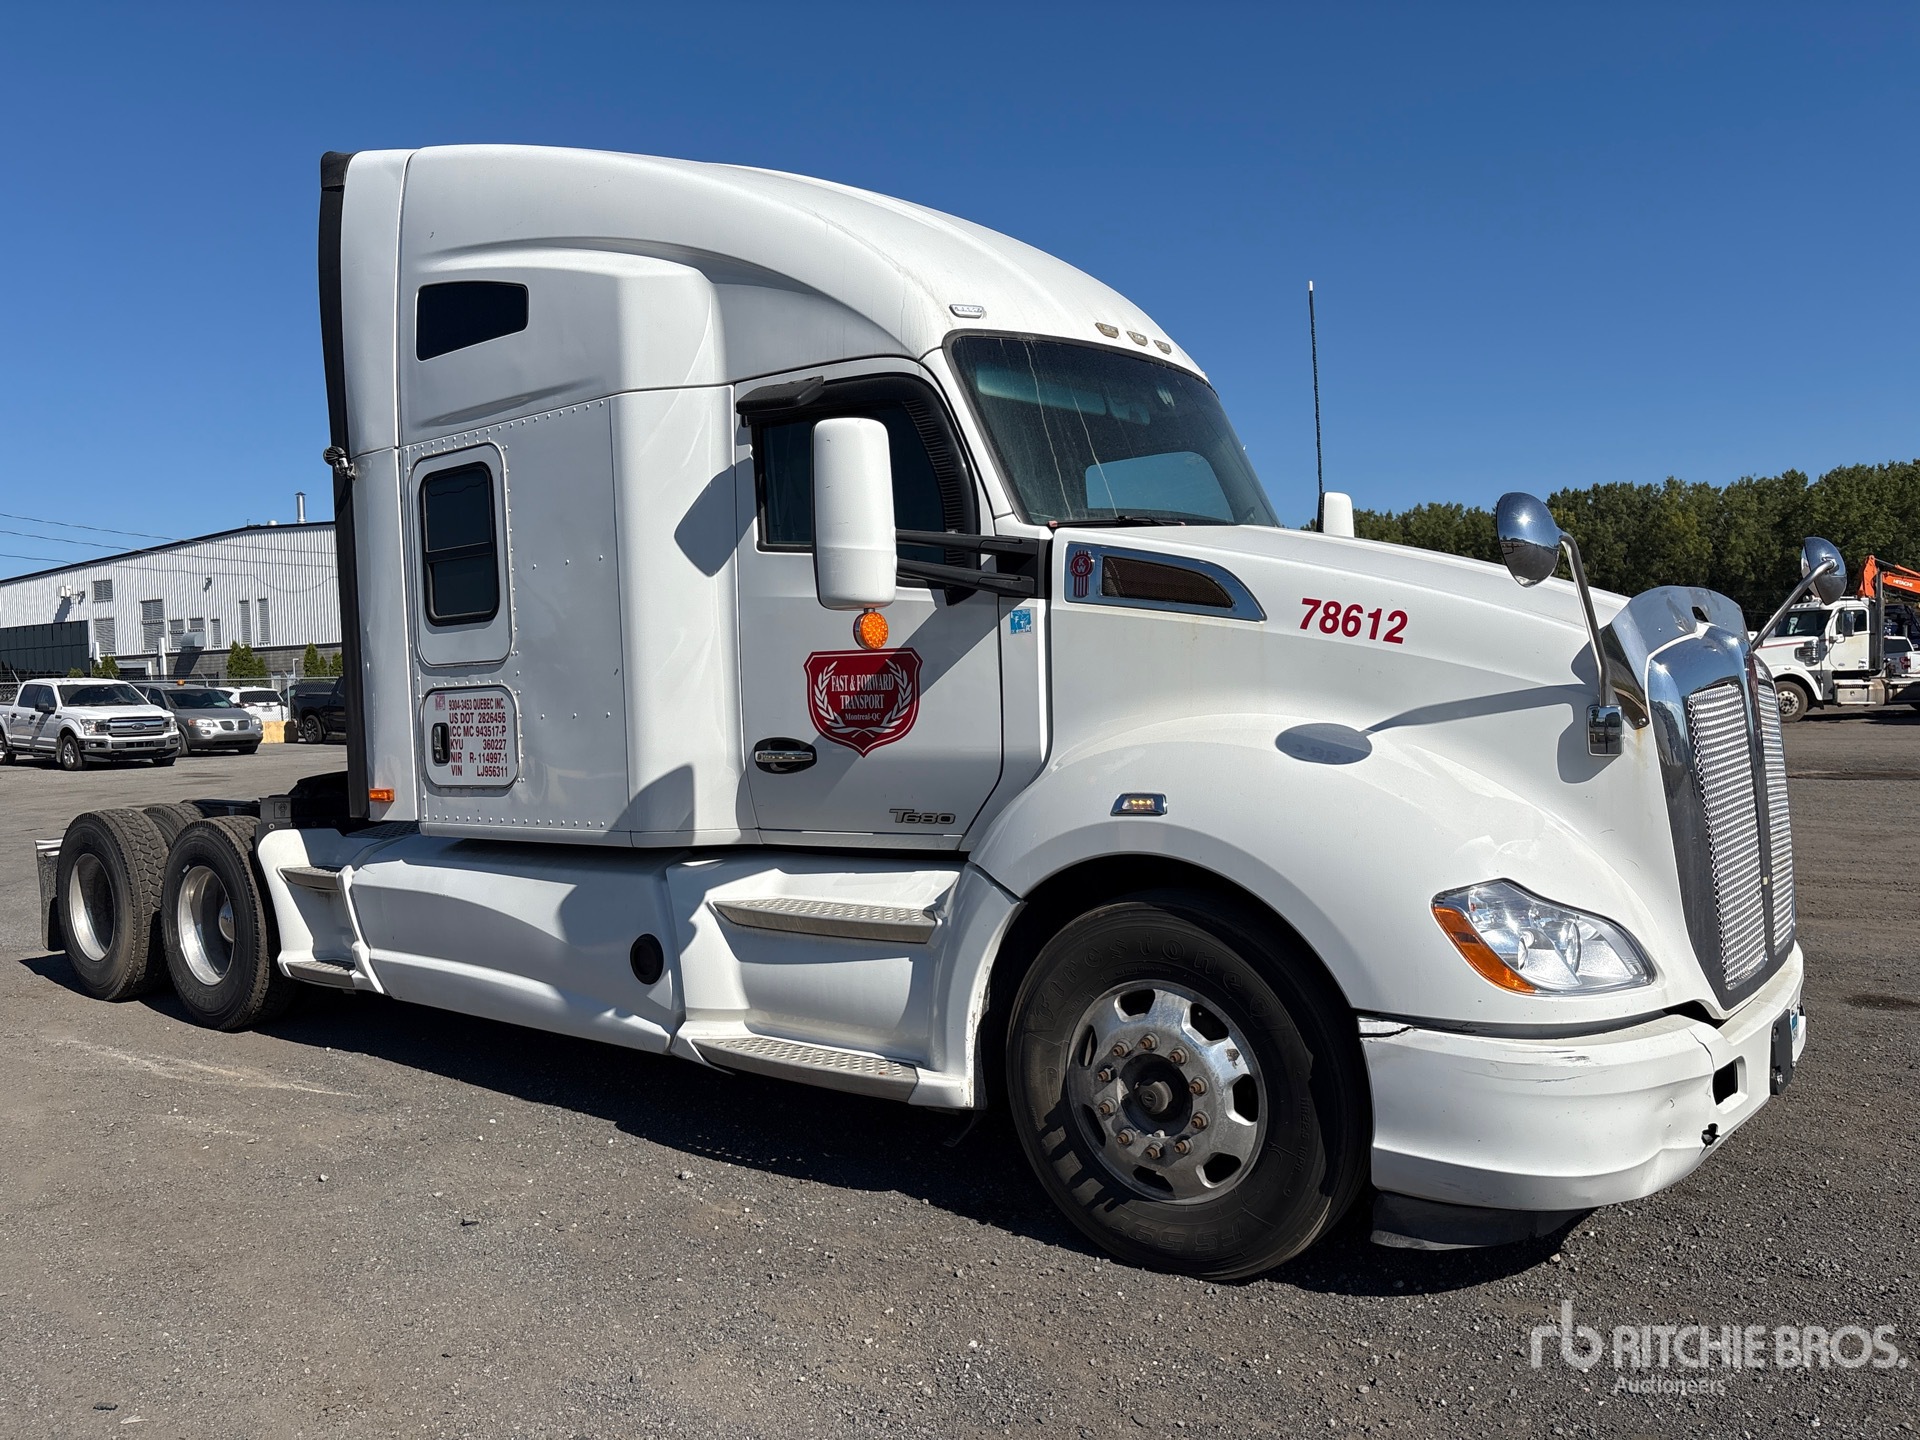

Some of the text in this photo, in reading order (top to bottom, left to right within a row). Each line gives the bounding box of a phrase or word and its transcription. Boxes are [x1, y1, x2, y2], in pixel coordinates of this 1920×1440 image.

[1892, 579, 1914, 588] HITACHI
[1300, 597, 1408, 644] 78612
[831, 673, 894, 692] FAST & FORWARD
[448, 699, 472, 711] 9304-3453
[472, 698, 494, 710] QUEBEC
[494, 697, 506, 710] INC.
[840, 694, 885, 710] TRANSPORT
[449, 711, 506, 724] US DOT 2826456
[449, 725, 507, 737] ICC MC 943517-P
[450, 738, 507, 751] KYU 360227
[450, 752, 463, 764] NIR
[451, 765, 508, 777] VIN LJ956311
[889, 808, 956, 824] T680
[1033, 932, 1243, 1021] Firestone
